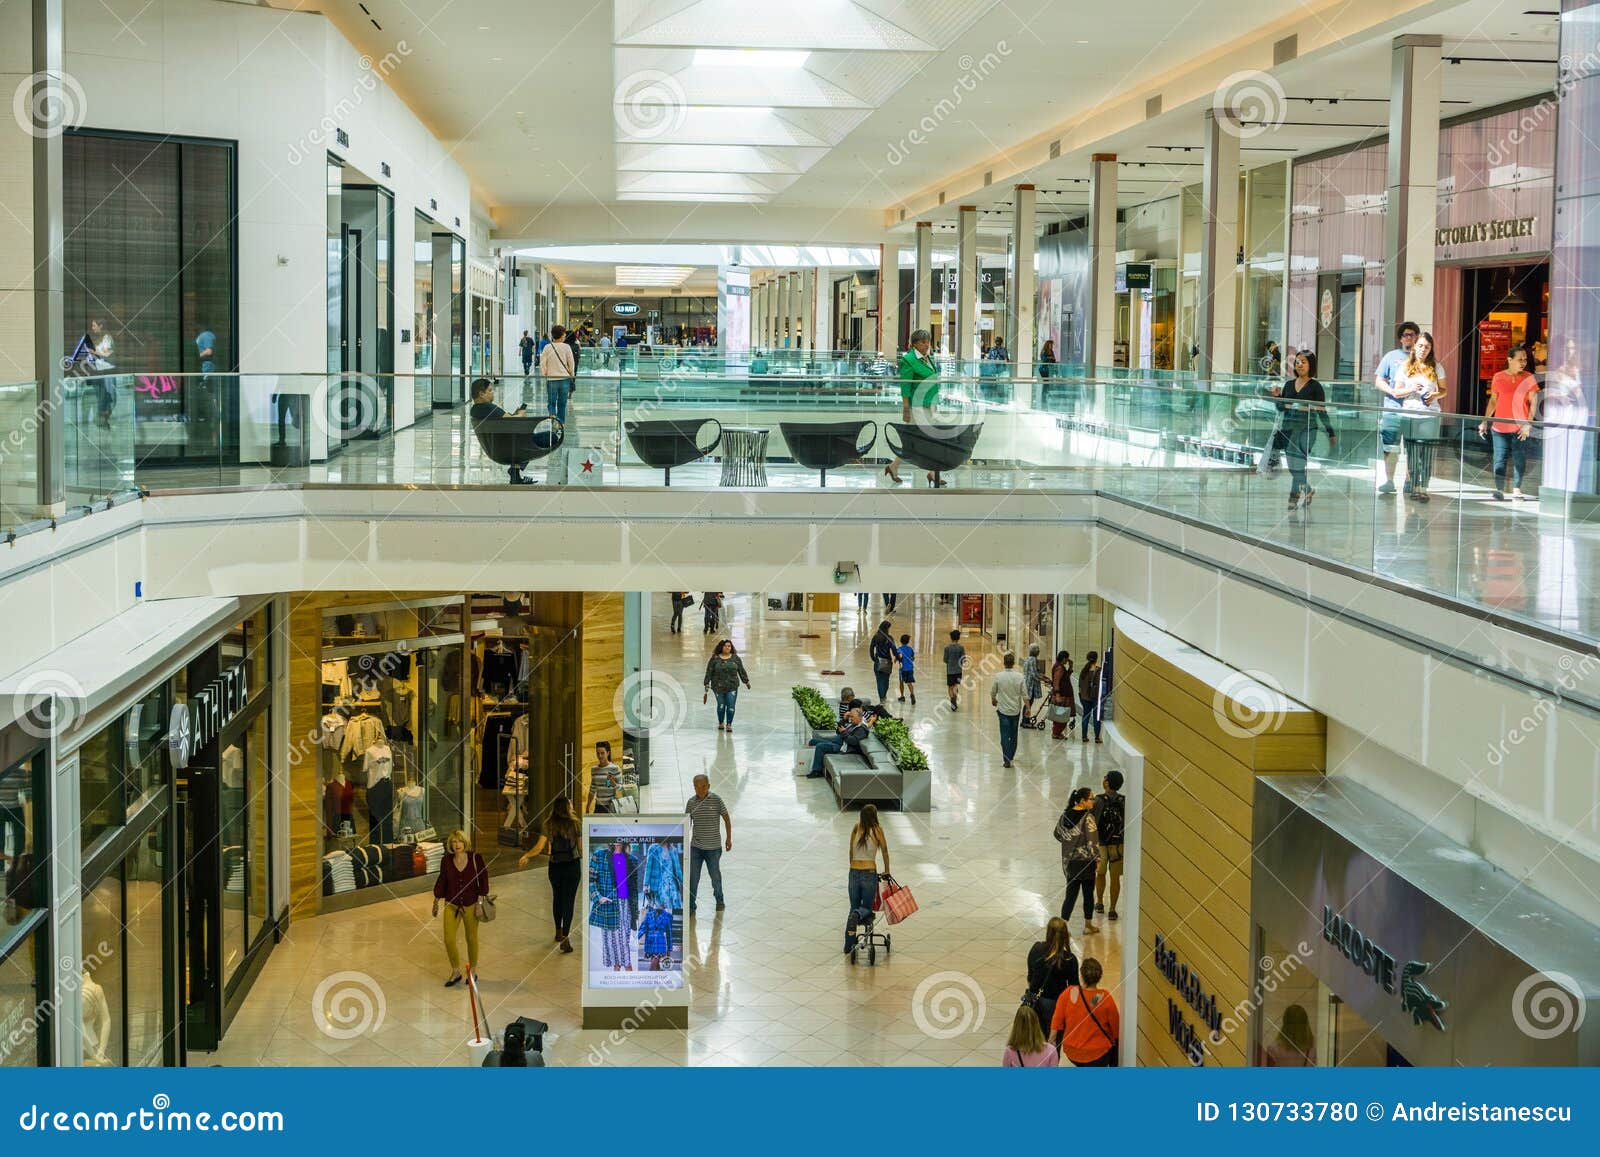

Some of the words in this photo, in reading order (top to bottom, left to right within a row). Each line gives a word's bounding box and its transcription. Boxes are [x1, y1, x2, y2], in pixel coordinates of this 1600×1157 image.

[1435, 222, 1488, 247] ICTORIA'S
[1489, 217, 1537, 241] SECRET
[615, 304, 625, 313] OLD
[1323, 904, 1397, 996] LACOSTE
